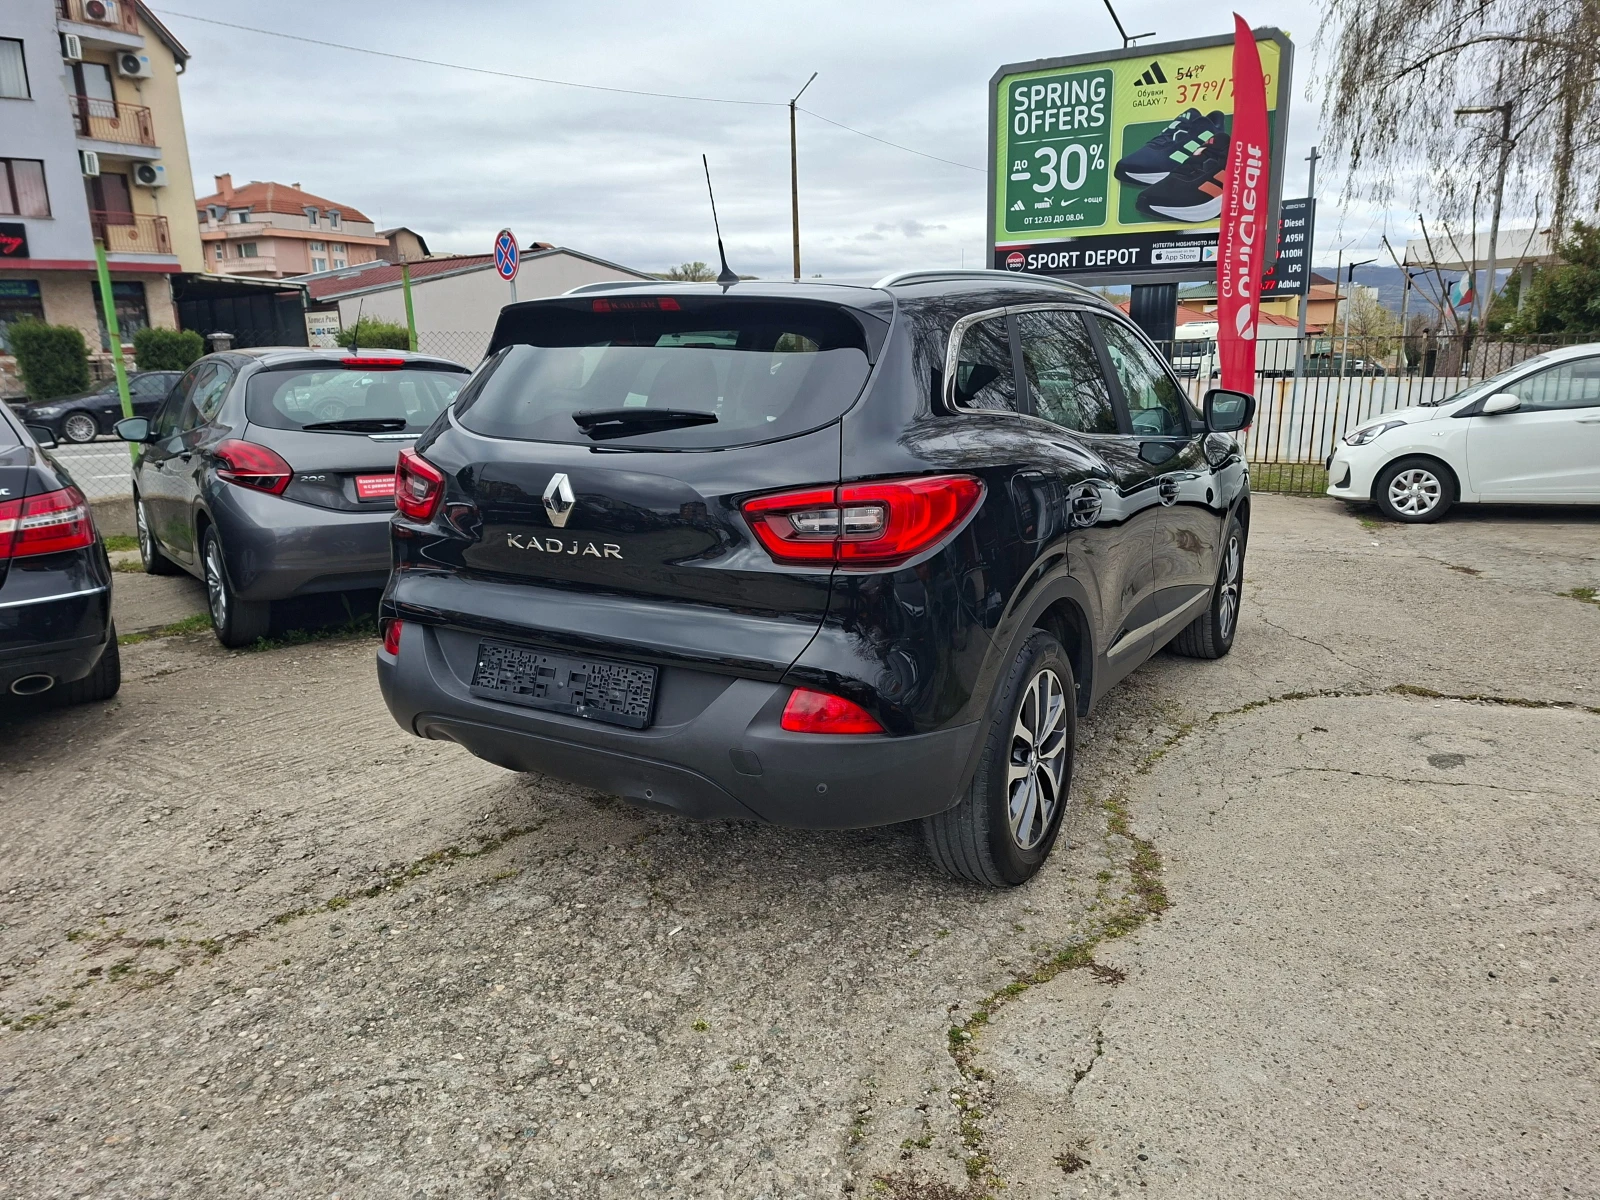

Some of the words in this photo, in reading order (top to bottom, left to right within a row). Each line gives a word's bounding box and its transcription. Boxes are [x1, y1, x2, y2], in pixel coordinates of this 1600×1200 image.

[1015, 77, 1106, 111] SPRING
[1137, 89, 1164, 98] Обувки
[1132, 100, 1161, 108] GALAXY
[1014, 103, 1105, 135] OFFERS
[1024, 217, 1033, 225] ОТ
[1034, 215, 1052, 224] 12.03
[1053, 215, 1064, 223] ДО
[1065, 213, 1084, 221] 08.04
[1284, 218, 1305, 228] Diesel
[1027, 252, 1080, 270] SPORT
[1085, 248, 1140, 266] DEPOT
[1288, 264, 1302, 273] LPG
[1278, 280, 1301, 289] Adblue
[507, 533, 623, 559] KADJAR
